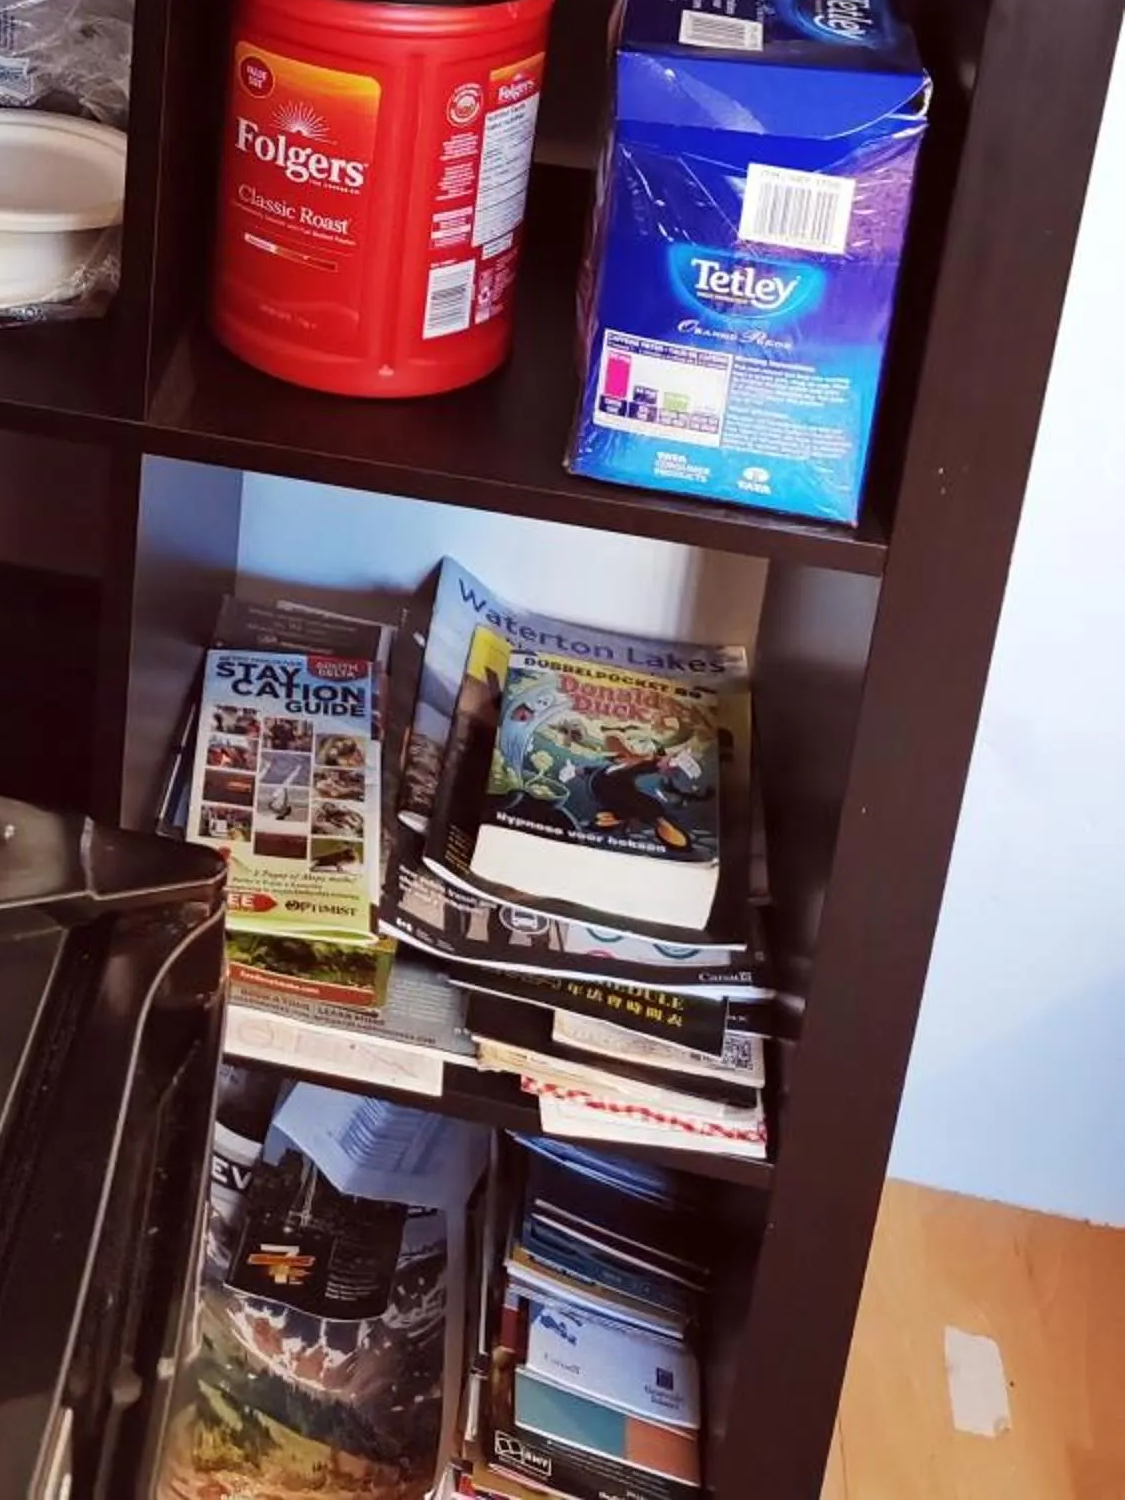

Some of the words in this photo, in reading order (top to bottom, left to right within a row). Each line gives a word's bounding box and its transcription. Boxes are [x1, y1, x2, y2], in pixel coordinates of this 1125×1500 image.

[235, 116, 365, 188] Folgers
[238, 183, 296, 219] Classic
[299, 206, 349, 235] Roast
[691, 258, 802, 309] Tetley
[459, 578, 613, 660] Waterton
[627, 647, 725, 676] Lakes
[216, 661, 302, 690] STAY
[285, 700, 365, 717] GUIDE
[228, 892, 254, 909] EE
